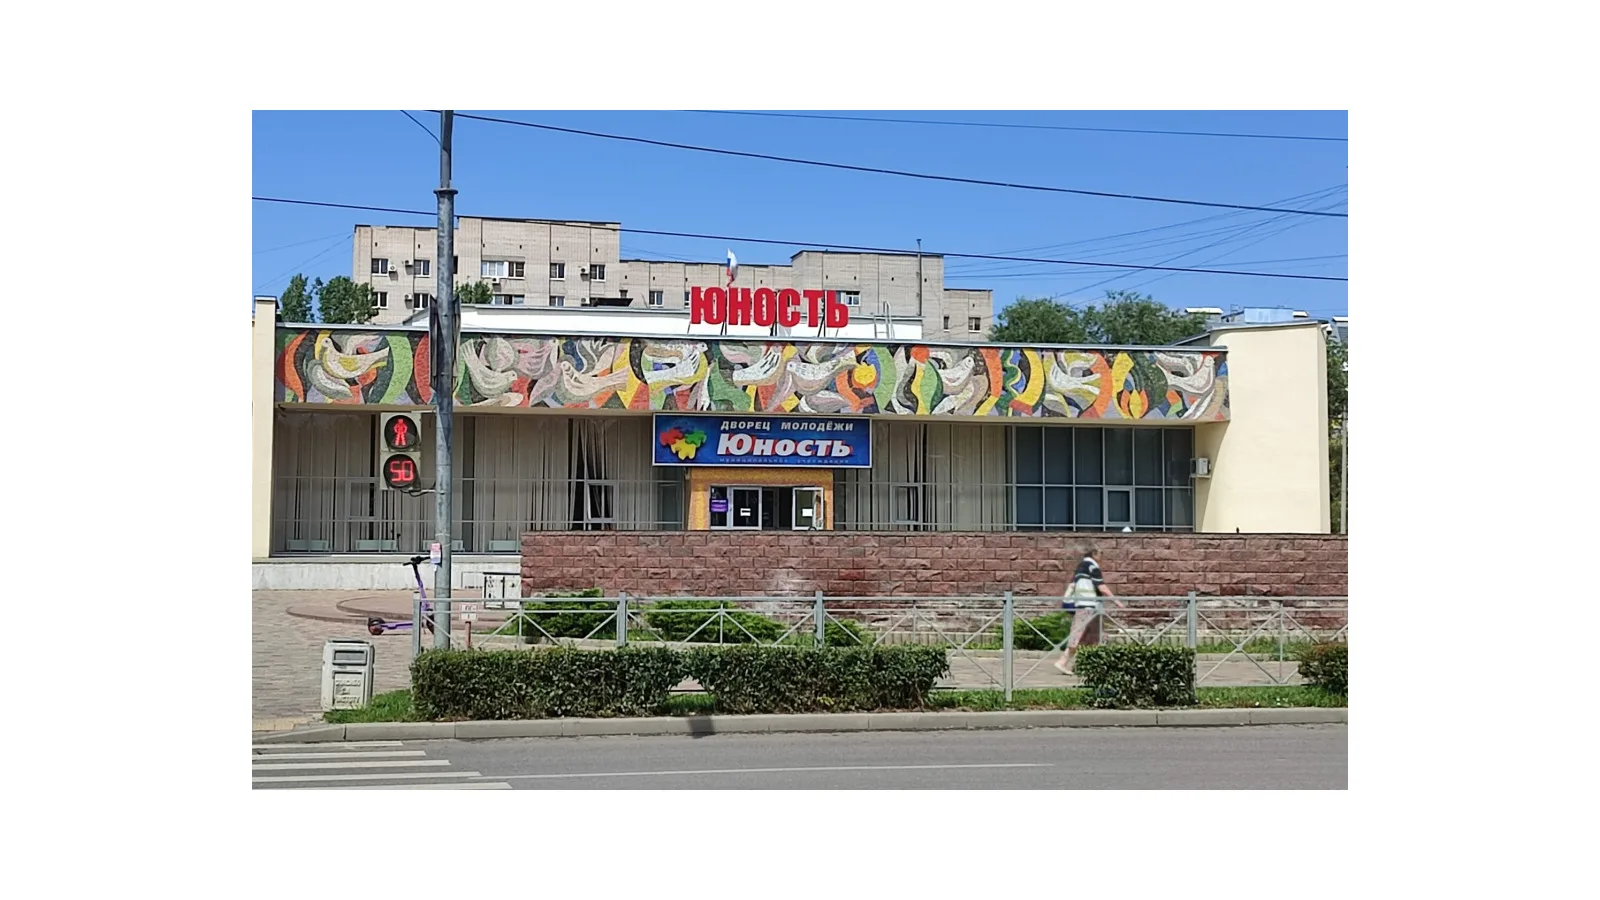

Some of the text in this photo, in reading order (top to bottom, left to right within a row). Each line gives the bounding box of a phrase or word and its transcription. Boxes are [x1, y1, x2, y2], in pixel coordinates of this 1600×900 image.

[691, 286, 849, 328] ЮНОСТЬ
[720, 420, 854, 432] ДВОРЕЦ МОЛОДЁЖИ
[717, 433, 853, 457] Юность
[390, 461, 413, 481] 50
